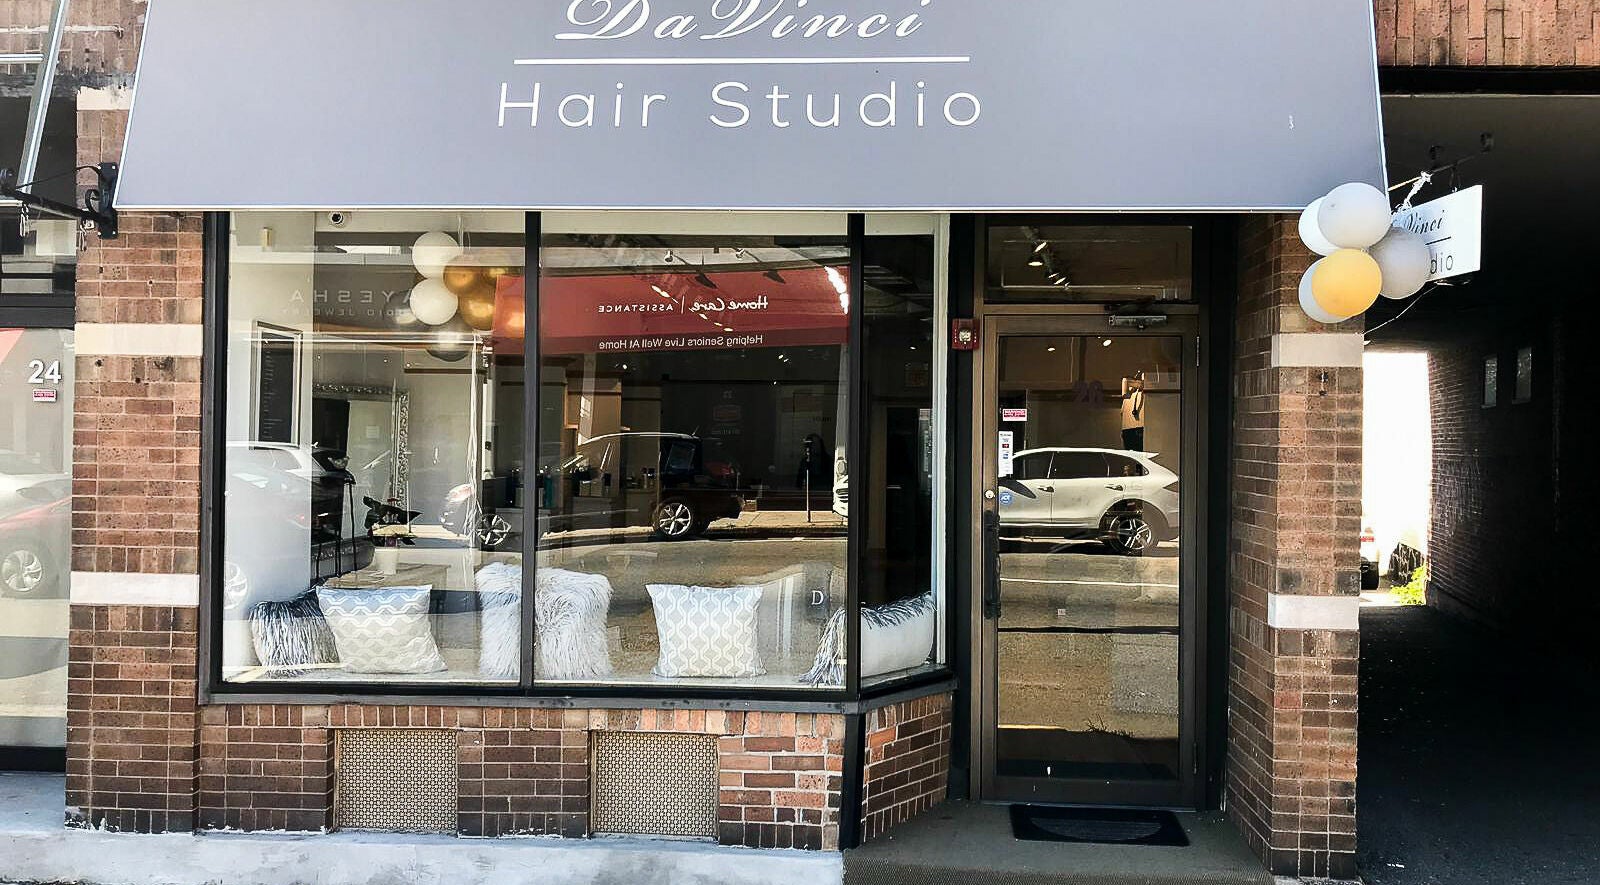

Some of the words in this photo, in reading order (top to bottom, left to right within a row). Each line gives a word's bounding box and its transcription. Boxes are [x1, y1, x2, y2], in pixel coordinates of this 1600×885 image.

[497, 82, 667, 128] Hair
[709, 81, 982, 128] Studio
[1429, 252, 1454, 275] dio
[28, 359, 62, 384] 24
[811, 590, 824, 605] D
